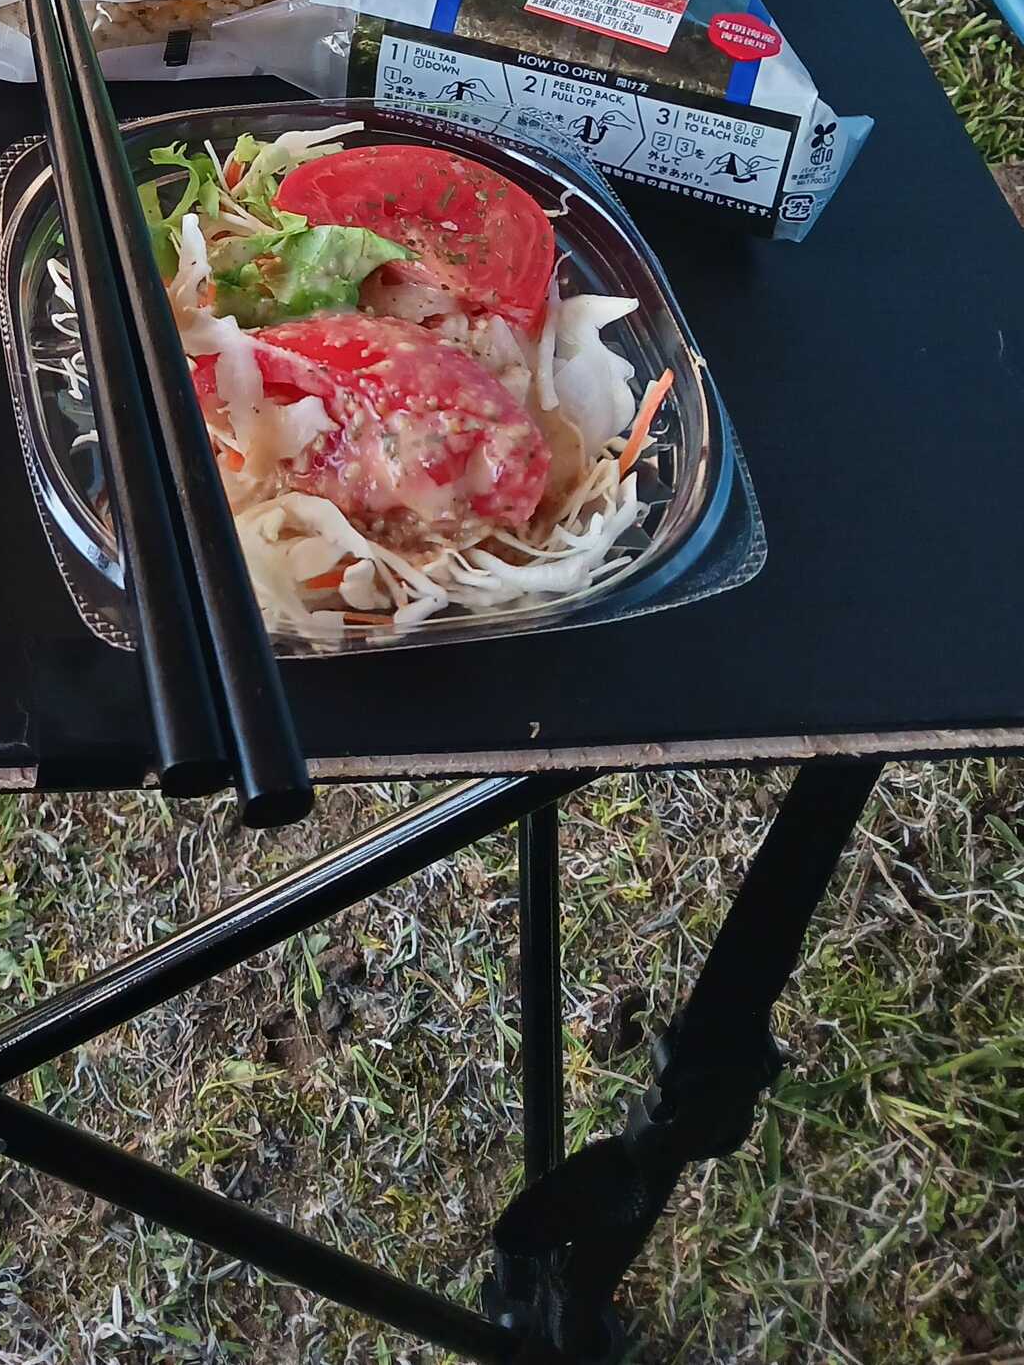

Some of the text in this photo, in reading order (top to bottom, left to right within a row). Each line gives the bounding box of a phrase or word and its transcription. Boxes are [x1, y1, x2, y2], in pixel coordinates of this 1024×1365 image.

[716, 19, 776, 44] 有明海産
[391, 43, 399, 61] 1
[415, 47, 457, 64] PULL TAB
[425, 61, 460, 76] DOWN
[517, 54, 607, 83] HOW TO OPEN
[523, 75, 537, 93] 2
[553, 80, 626, 106] PEEL TO BACK,
[616, 76, 649, 93] 開け方
[551, 91, 597, 108] PULL OFF
[656, 108, 671, 125] 3
[686, 112, 710, 125] PULL
[713, 118, 732, 130] TAB
[685, 122, 758, 148] TO EACH SIDE
[647, 150, 682, 166] 外して
